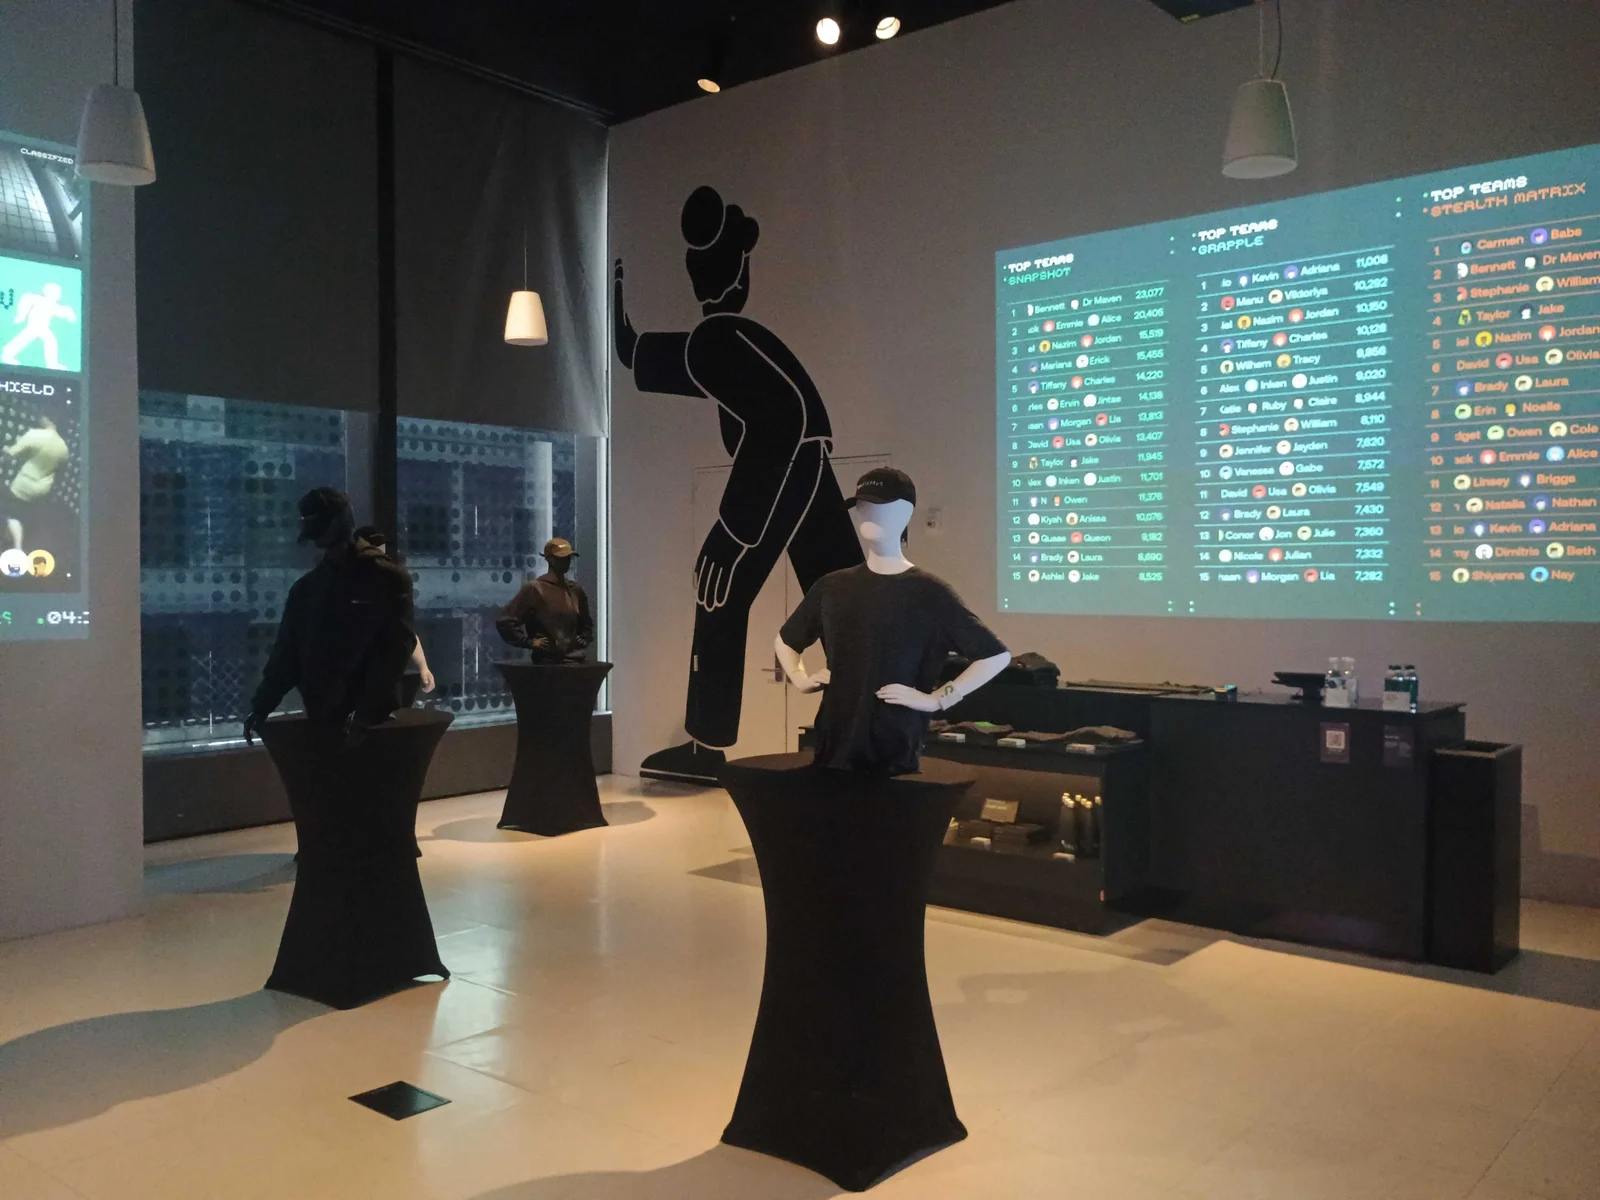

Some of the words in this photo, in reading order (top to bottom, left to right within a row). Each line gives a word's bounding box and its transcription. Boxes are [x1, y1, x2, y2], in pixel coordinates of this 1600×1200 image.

[21, 148, 73, 164] CLASSIFIED
[1431, 186, 1464, 202] TOP
[1469, 176, 1528, 195] TEAMS
[1431, 195, 1508, 217] STEALTH
[1514, 183, 1586, 203] MATRIX
[1198, 228, 1226, 241] TOP
[1230, 219, 1278, 236] TEAMS
[1198, 235, 1264, 255] GRAPPLE
[1434, 247, 1439, 256] 1
[1477, 235, 1524, 249] Carmen
[1551, 227, 1582, 240] Babe
[1008, 261, 1031, 273] TOP
[1034, 253, 1074, 268] TEAMS
[1434, 270, 1441, 280] 2
[1471, 260, 1516, 274] Bennett
[1543, 255, 1557, 265] Dr
[1008, 267, 1071, 285] SNAPSHOT
[1201, 282, 1206, 290] 1
[1252, 272, 1279, 282] Kevin
[1301, 263, 1340, 276] Adriana
[1035, 303, 1066, 314] Bennett
[1083, 297, 1092, 306] Dr
[1094, 295, 1122, 305] Maven
[1135, 288, 1164, 299] 23,077
[1433, 293, 1441, 303] 3
[1471, 283, 1529, 298] Stephanie
[1201, 302, 1208, 311] 2
[1201, 324, 1208, 332] 3
[1253, 315, 1283, 326] Nazim
[1304, 307, 1339, 319] Jordan
[1433, 316, 1441, 326] 4
[1476, 310, 1511, 321] Taylor
[1538, 304, 1564, 314] Jake
[1012, 328, 1017, 336] 2
[1056, 320, 1083, 330] Emmie
[1101, 315, 1122, 323] Alice
[1012, 347, 1017, 355] 3
[1052, 340, 1077, 350] Nazim
[1094, 334, 1122, 344] Jordan
[1236, 338, 1268, 350] Tiffany
[1289, 331, 1328, 343] Charles
[1433, 339, 1440, 349] 5
[1495, 331, 1532, 343] Nazim
[1559, 325, 1600, 337] Jordan
[1090, 356, 1110, 365] Erick
[1201, 365, 1207, 374] 5
[1293, 354, 1321, 365] Tracy
[1457, 359, 1490, 371] David
[1566, 350, 1600, 361] Olivia
[1012, 385, 1017, 393] 5
[1041, 381, 1067, 391] Tiffany
[1084, 376, 1116, 386] Charles
[1136, 371, 1163, 381] 14,220
[1201, 386, 1207, 395] 6
[1309, 374, 1338, 385] Justin
[1432, 386, 1439, 396] 7
[1475, 381, 1508, 393] Brady
[1536, 377, 1569, 387] Laura
[1012, 404, 1017, 412] 6
[1060, 399, 1080, 408] Ervin
[1200, 407, 1207, 416] 7
[1262, 401, 1287, 411] Ruby
[1474, 406, 1496, 416] Erin
[1012, 423, 1017, 431] 7
[1061, 417, 1092, 428] Morgan
[1200, 428, 1207, 436] 8
[1231, 423, 1279, 435] Stephanie
[1507, 427, 1542, 437] Owen
[1570, 424, 1599, 434] Cole
[1099, 434, 1121, 443] Olivia
[1136, 432, 1163, 442] 13,407
[1200, 449, 1207, 457] 9
[1234, 444, 1271, 455] Jennifer
[1293, 441, 1328, 452] Jayden
[1430, 456, 1443, 465] 10
[1567, 448, 1598, 458] Alice
[1041, 458, 1064, 468] Taylor
[1081, 456, 1099, 465] Jake
[1012, 479, 1020, 487] 10
[1098, 474, 1121, 483] Justin
[1200, 470, 1210, 478] 10
[1200, 491, 1207, 499] 11
[1221, 488, 1247, 498] David
[1309, 484, 1336, 494] Olivia
[1012, 516, 1020, 524] 12
[1200, 511, 1209, 519] 12
[1234, 509, 1261, 519] Brady
[1283, 507, 1310, 516] Laura
[1355, 505, 1384, 515] 7,430
[1200, 532, 1210, 540] 13
[1275, 529, 1292, 539] Jon
[1314, 529, 1336, 537] Julie
[1041, 554, 1063, 562] Brady
[1081, 553, 1103, 561] Laura
[1200, 552, 1210, 560] 14
[1234, 552, 1263, 560] Nicole
[1013, 572, 1020, 580] 15
[1082, 573, 1099, 581] Jake
[1200, 573, 1210, 581] 15
[1261, 572, 1299, 583] Morgan
[47, 611, 89, 624] 04:
